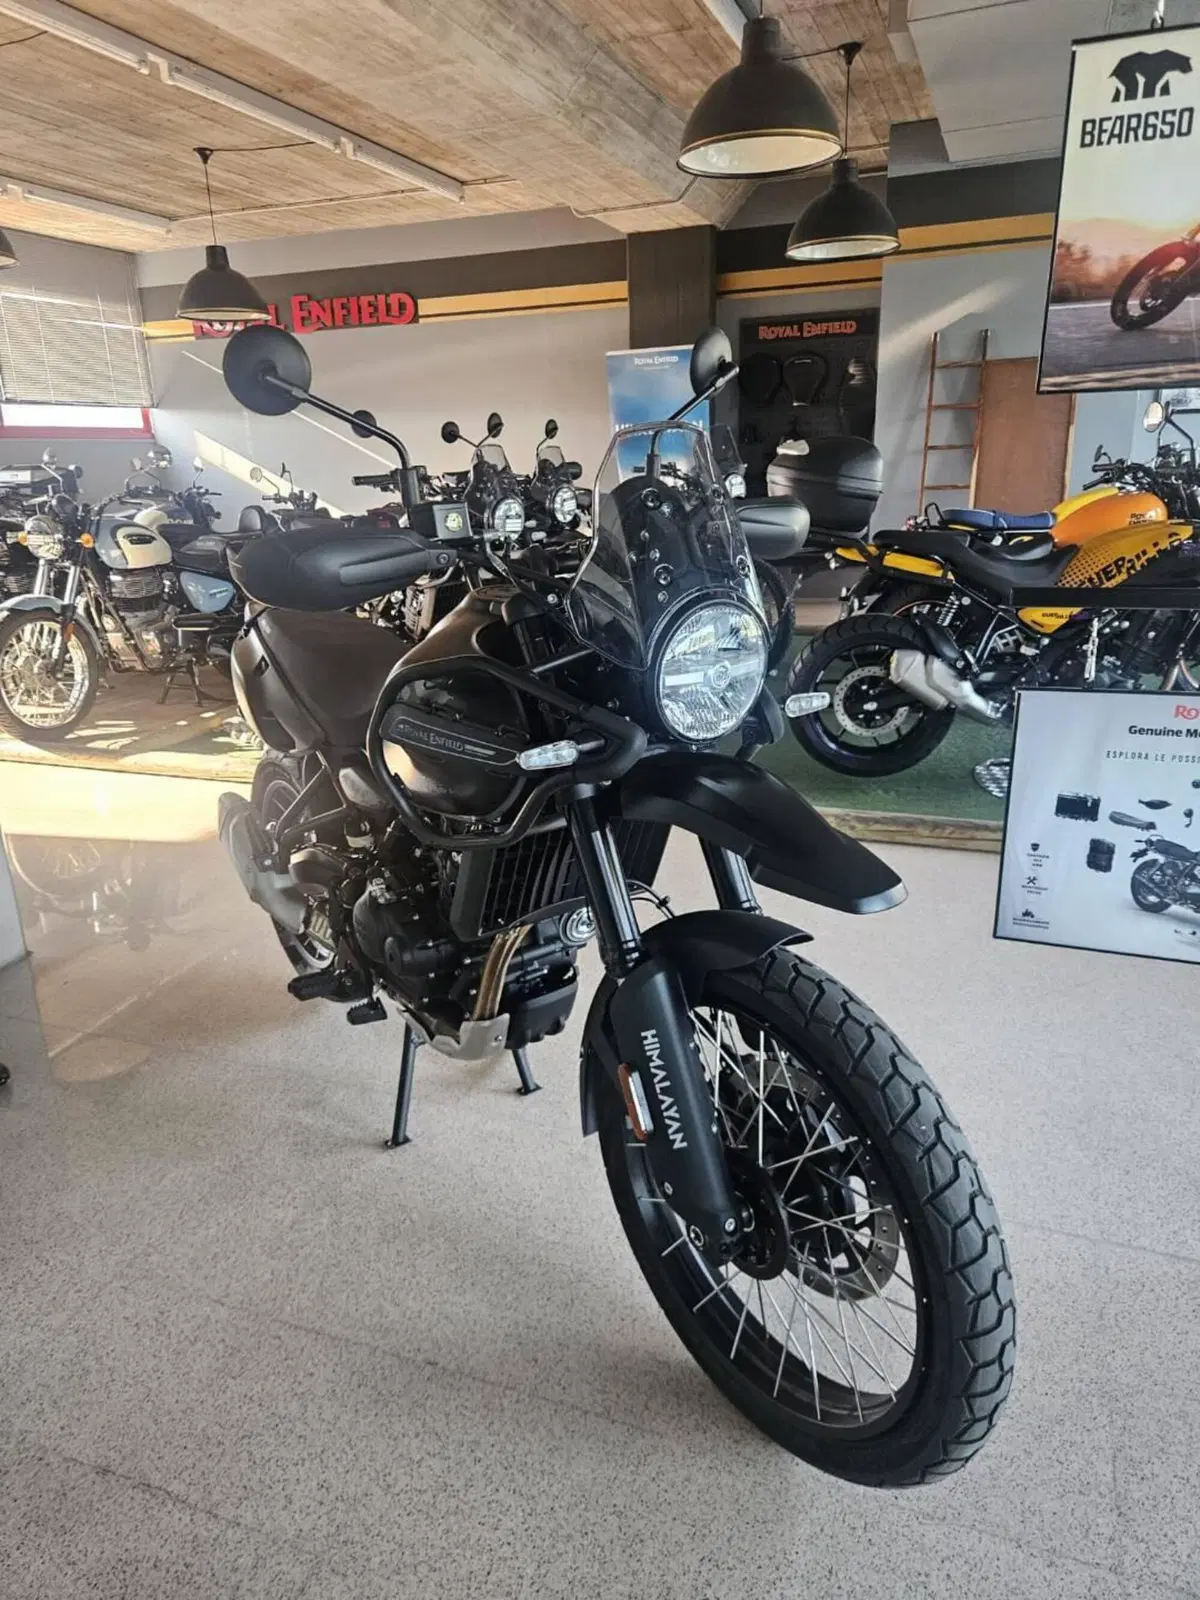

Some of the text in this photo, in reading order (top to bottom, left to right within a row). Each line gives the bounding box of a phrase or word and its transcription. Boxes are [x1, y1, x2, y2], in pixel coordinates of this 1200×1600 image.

[291, 293, 415, 333] ENFIELD
[759, 321, 856, 339] ROYAL ENFIELD
[1174, 704, 1200, 721] RO
[1128, 725, 1200, 739] Genuine M
[430, 732, 464, 751] ENFIELD
[1106, 750, 1149, 761] ESPLORA
[1155, 753, 1166, 762] LE
[641, 1029, 688, 1149] HIMALAYAN
